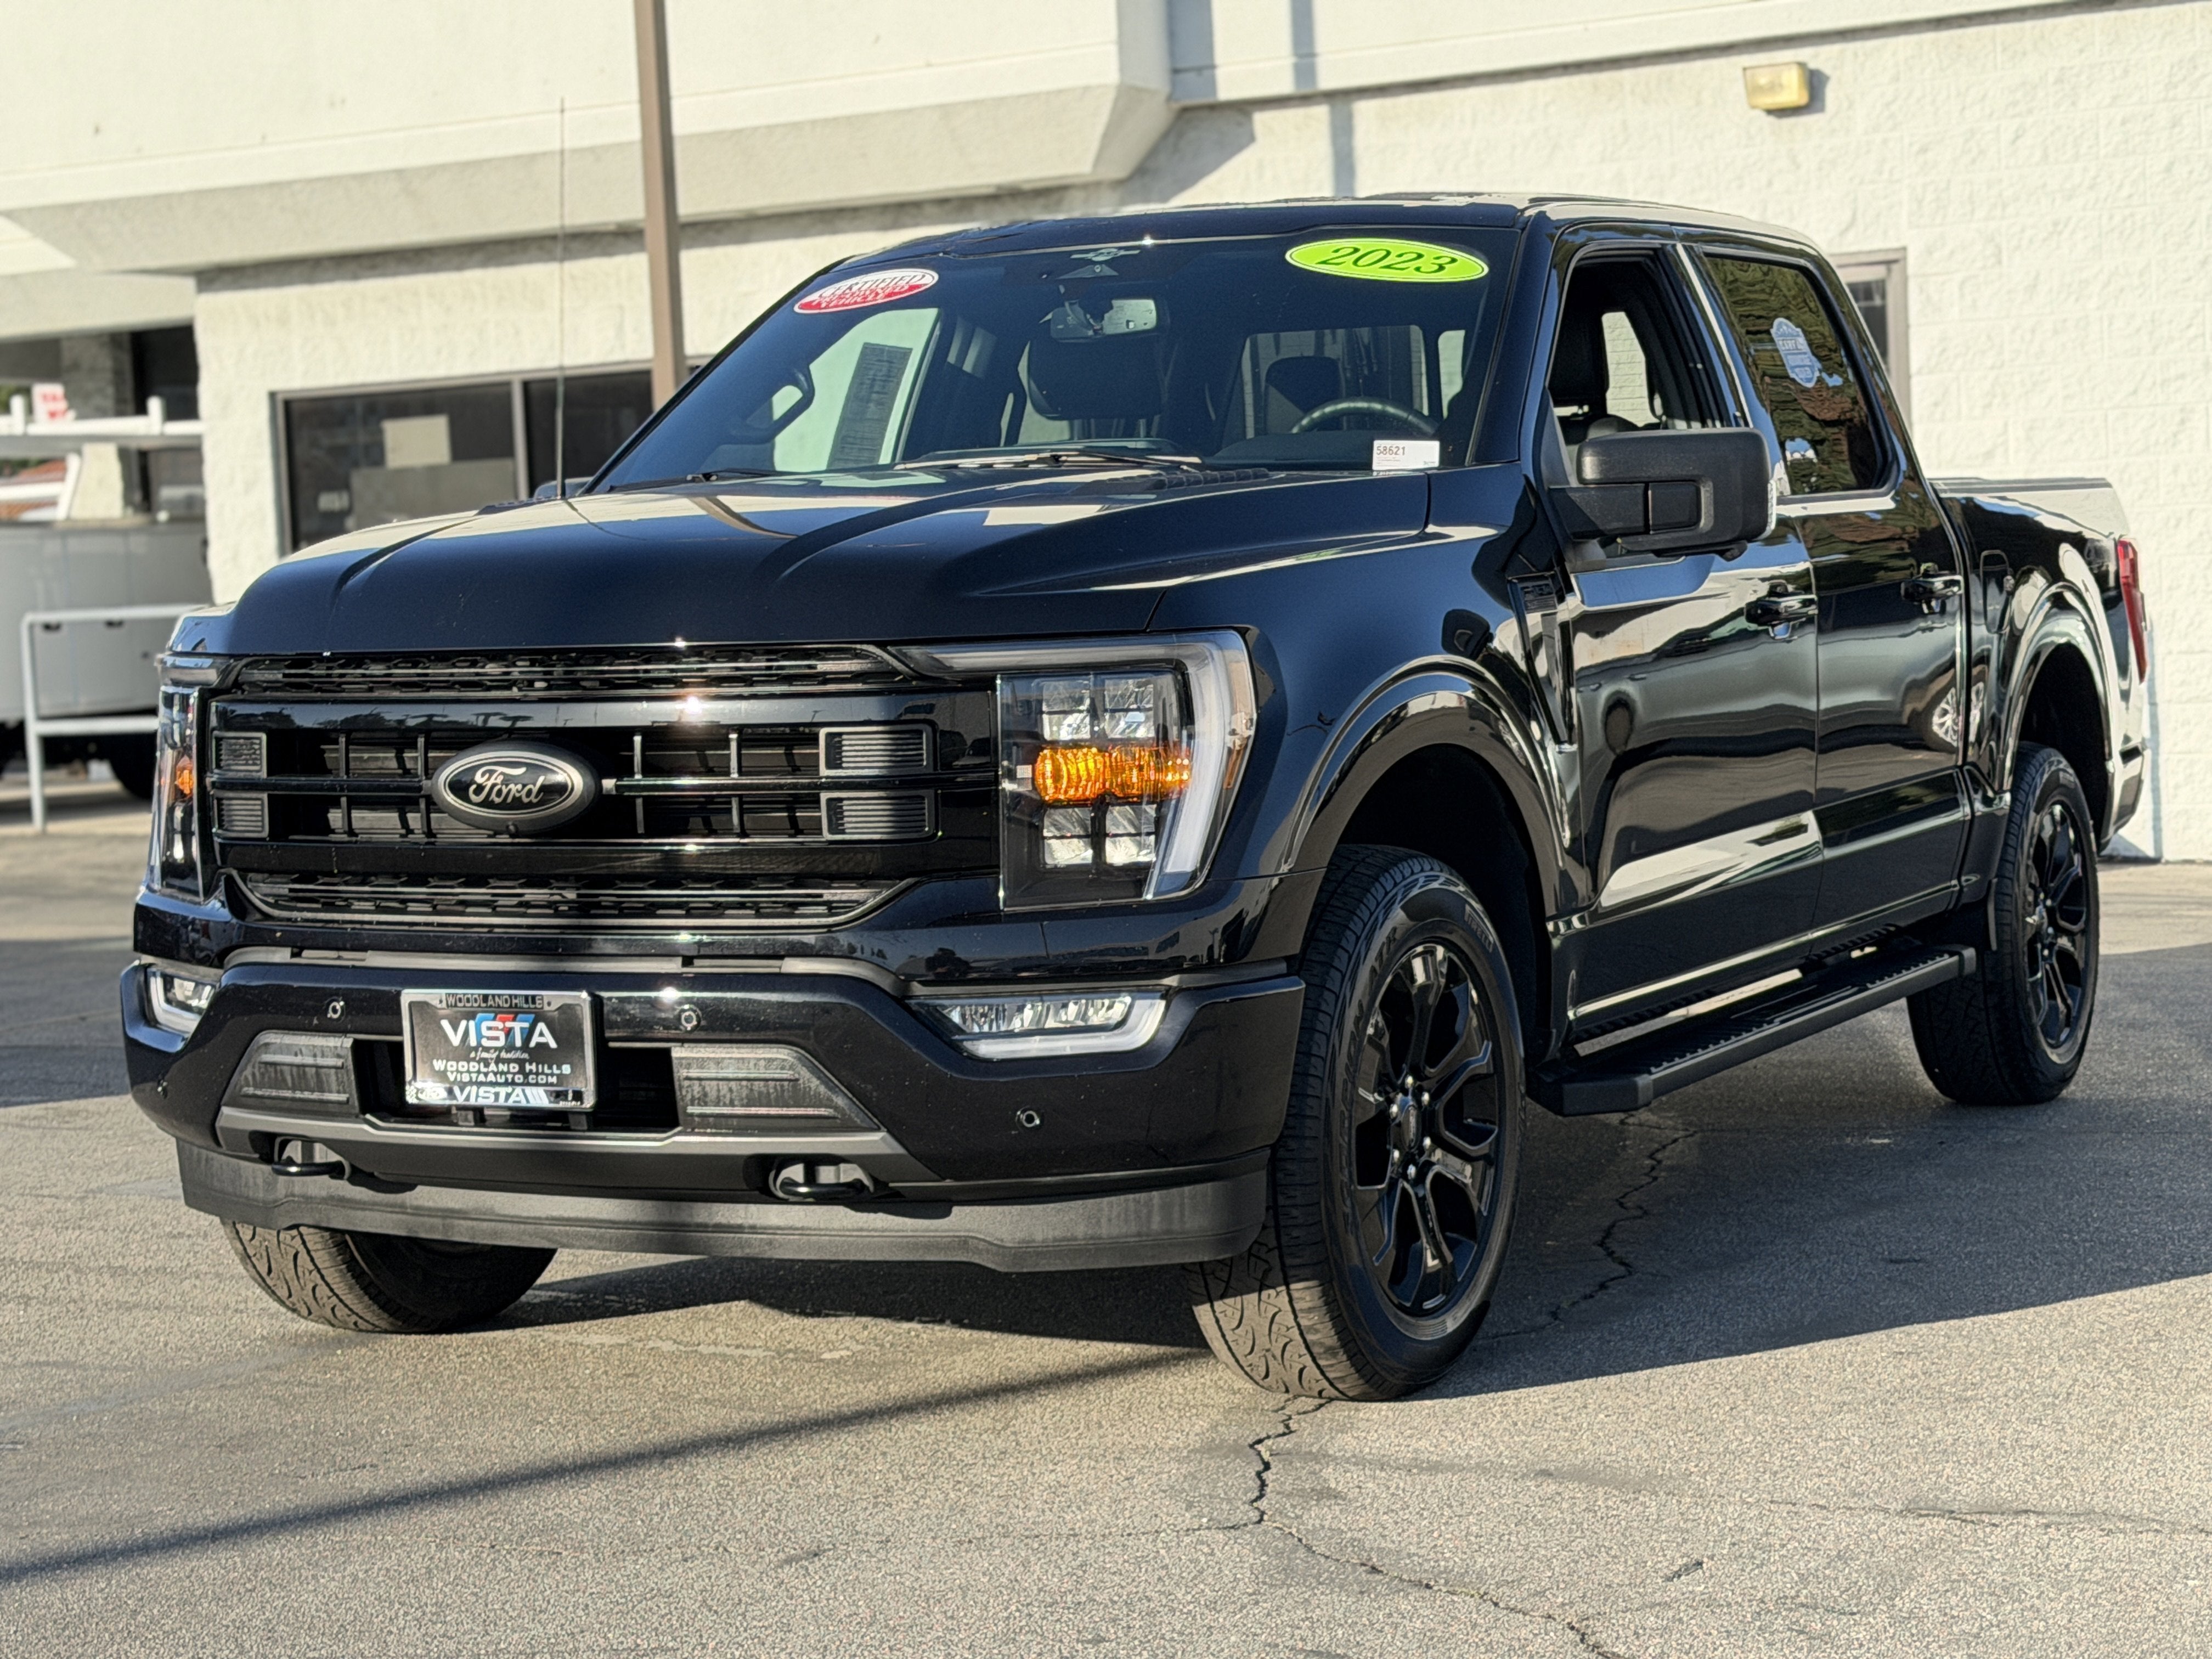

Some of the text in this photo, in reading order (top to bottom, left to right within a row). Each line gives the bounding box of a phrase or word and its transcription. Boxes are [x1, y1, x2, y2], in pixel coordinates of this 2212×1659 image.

[1315, 246, 1458, 274] 2023
[818, 274, 926, 297] CERTIFIED
[469, 766, 545, 803] Ford
[1464, 904, 1493, 953] PIRELLI
[446, 994, 543, 1008] WOODLAND HILLS
[441, 1019, 557, 1048] VISTA
[433, 1059, 571, 1074] WOODLAND HILLS
[453, 1086, 527, 1104] VISTA
